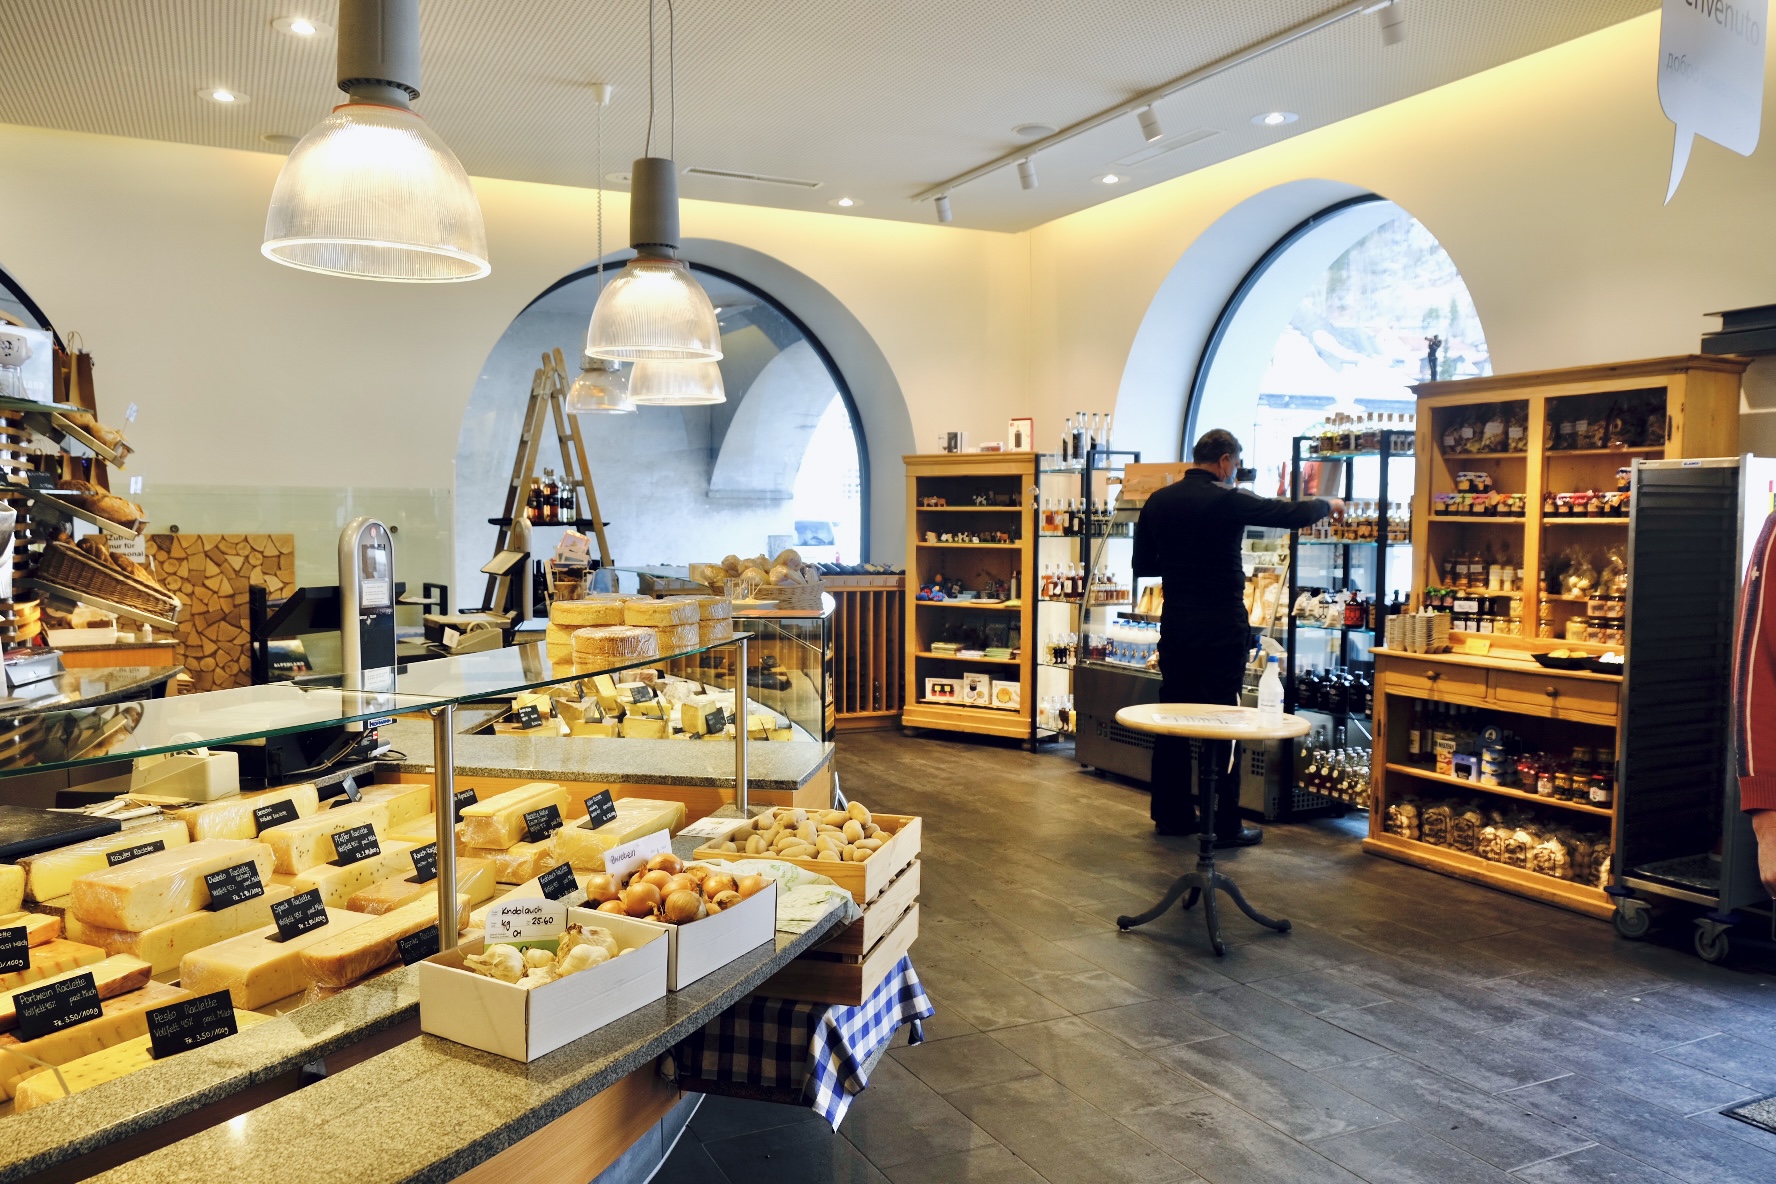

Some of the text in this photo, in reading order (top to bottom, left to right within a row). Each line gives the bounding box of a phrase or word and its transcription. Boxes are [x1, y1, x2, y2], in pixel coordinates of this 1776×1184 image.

[501, 905, 543, 916] Knoblauch
[19, 978, 87, 1005] Portwein Raclette
[153, 997, 218, 1024] Pesto Raclette
[195, 1026, 229, 1042] 3.50/100g
